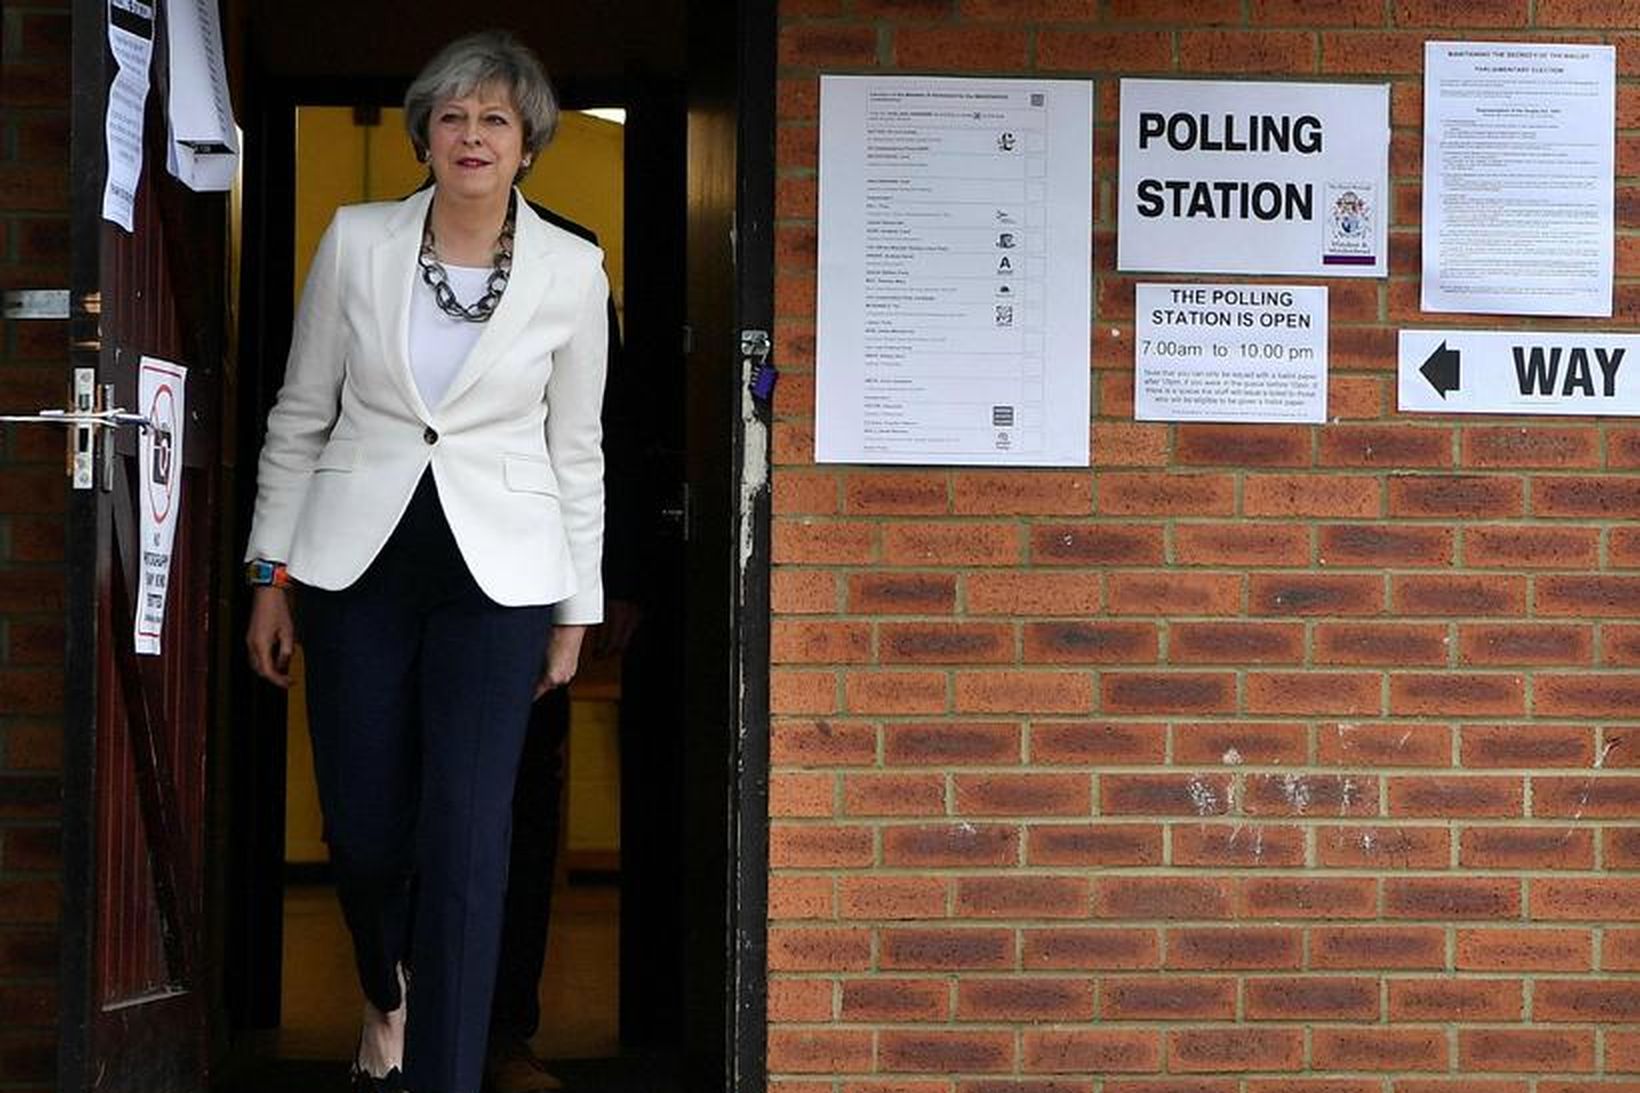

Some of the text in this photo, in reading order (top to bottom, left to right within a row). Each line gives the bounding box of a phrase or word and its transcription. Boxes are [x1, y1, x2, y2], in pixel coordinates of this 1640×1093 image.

[1139, 111, 1323, 154] POLLING
[1136, 179, 1313, 221] STATION
[1170, 289, 1293, 307] THE POLLING
[1152, 310, 1311, 328] STATION IS OPEN
[1142, 340, 1313, 361] 7.00am to 10.00 pm
[1512, 346, 1626, 397] WAY
